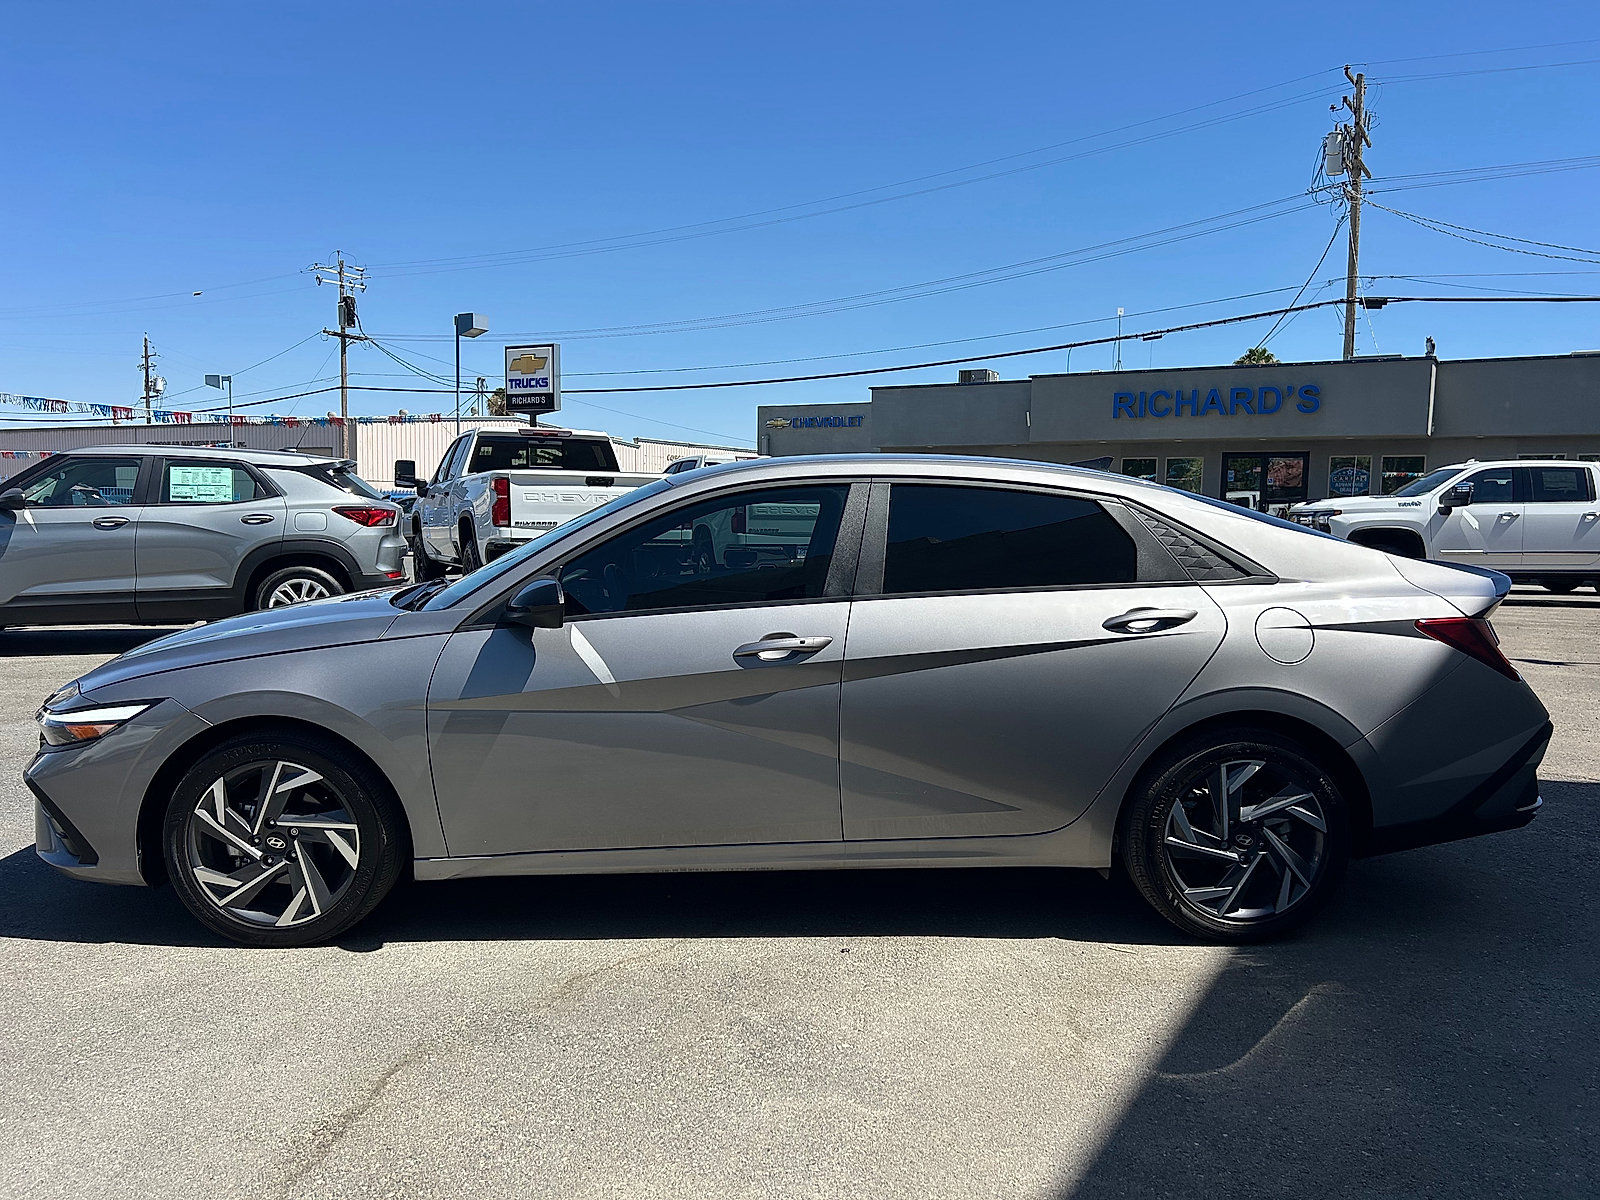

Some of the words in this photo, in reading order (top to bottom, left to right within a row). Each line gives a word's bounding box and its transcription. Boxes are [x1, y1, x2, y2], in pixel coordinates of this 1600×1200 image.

[508, 377, 549, 389] TRUCKS
[512, 396, 546, 405] RICHARD'S
[1112, 384, 1322, 419] RICHARD'S
[792, 416, 864, 429] CHEVROLET
[522, 492, 621, 504] CHEVR
